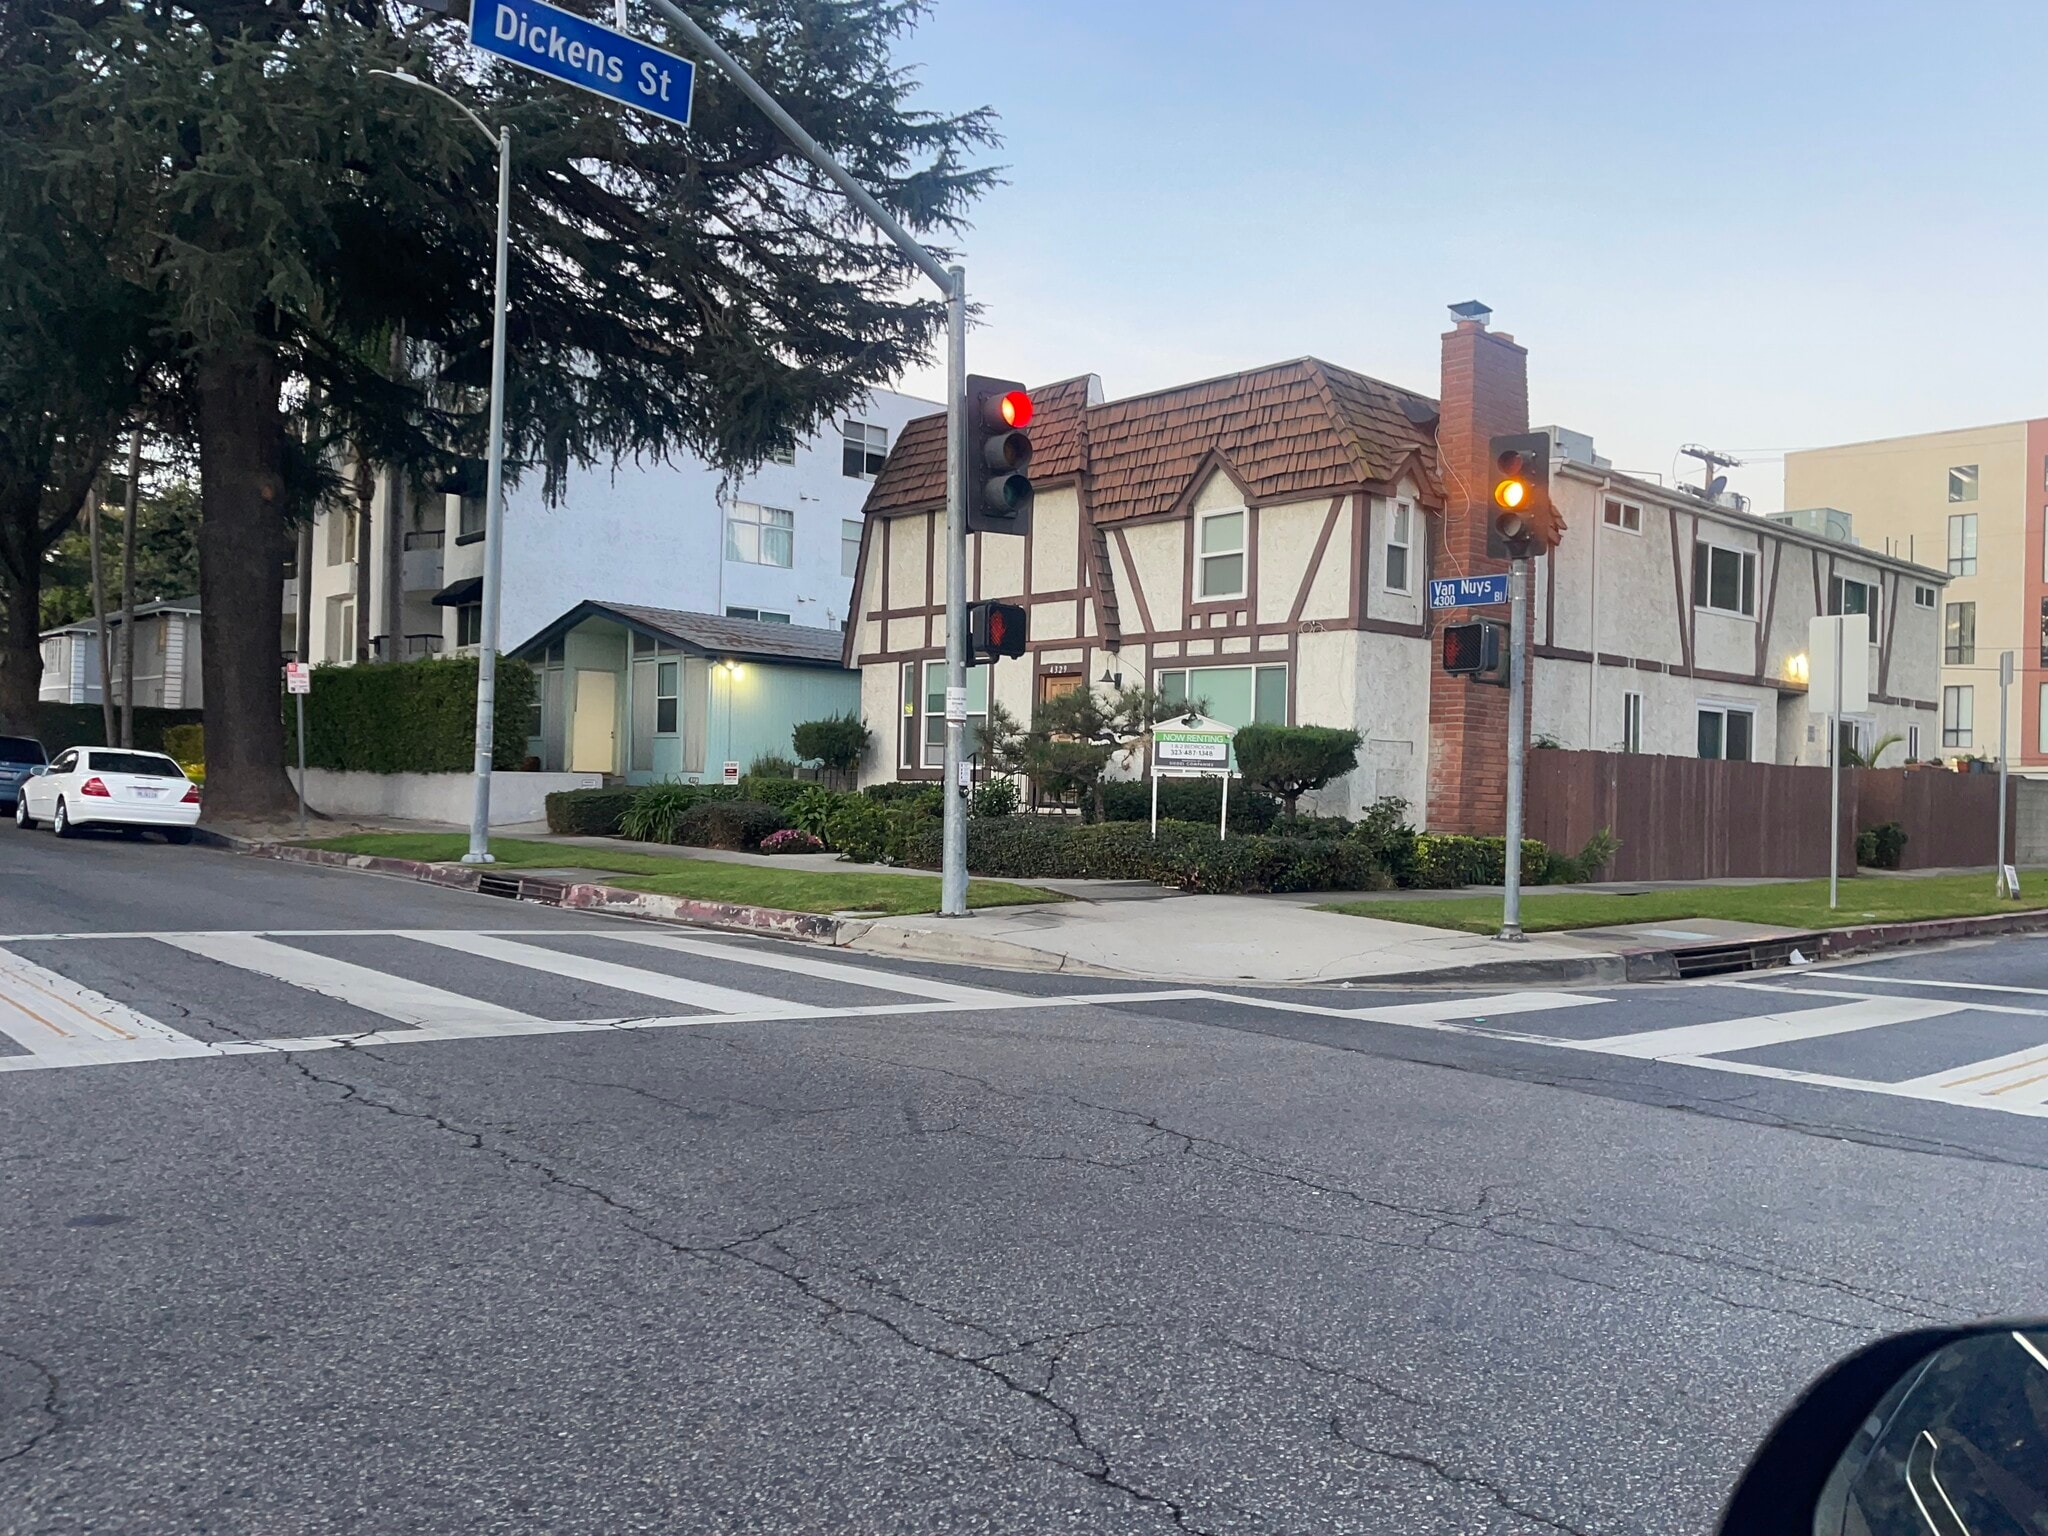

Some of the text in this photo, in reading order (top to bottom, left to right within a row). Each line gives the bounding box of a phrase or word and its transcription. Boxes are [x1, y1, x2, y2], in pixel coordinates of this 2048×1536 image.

[495, 3, 672, 102] Dickens St
[1434, 580, 1491, 597] Van Nuys
[1434, 596, 1455, 606] 4300
[1494, 591, 1503, 602] Bl
[1049, 665, 1068, 674] 4329
[1163, 733, 1223, 743] NOW RENTING
